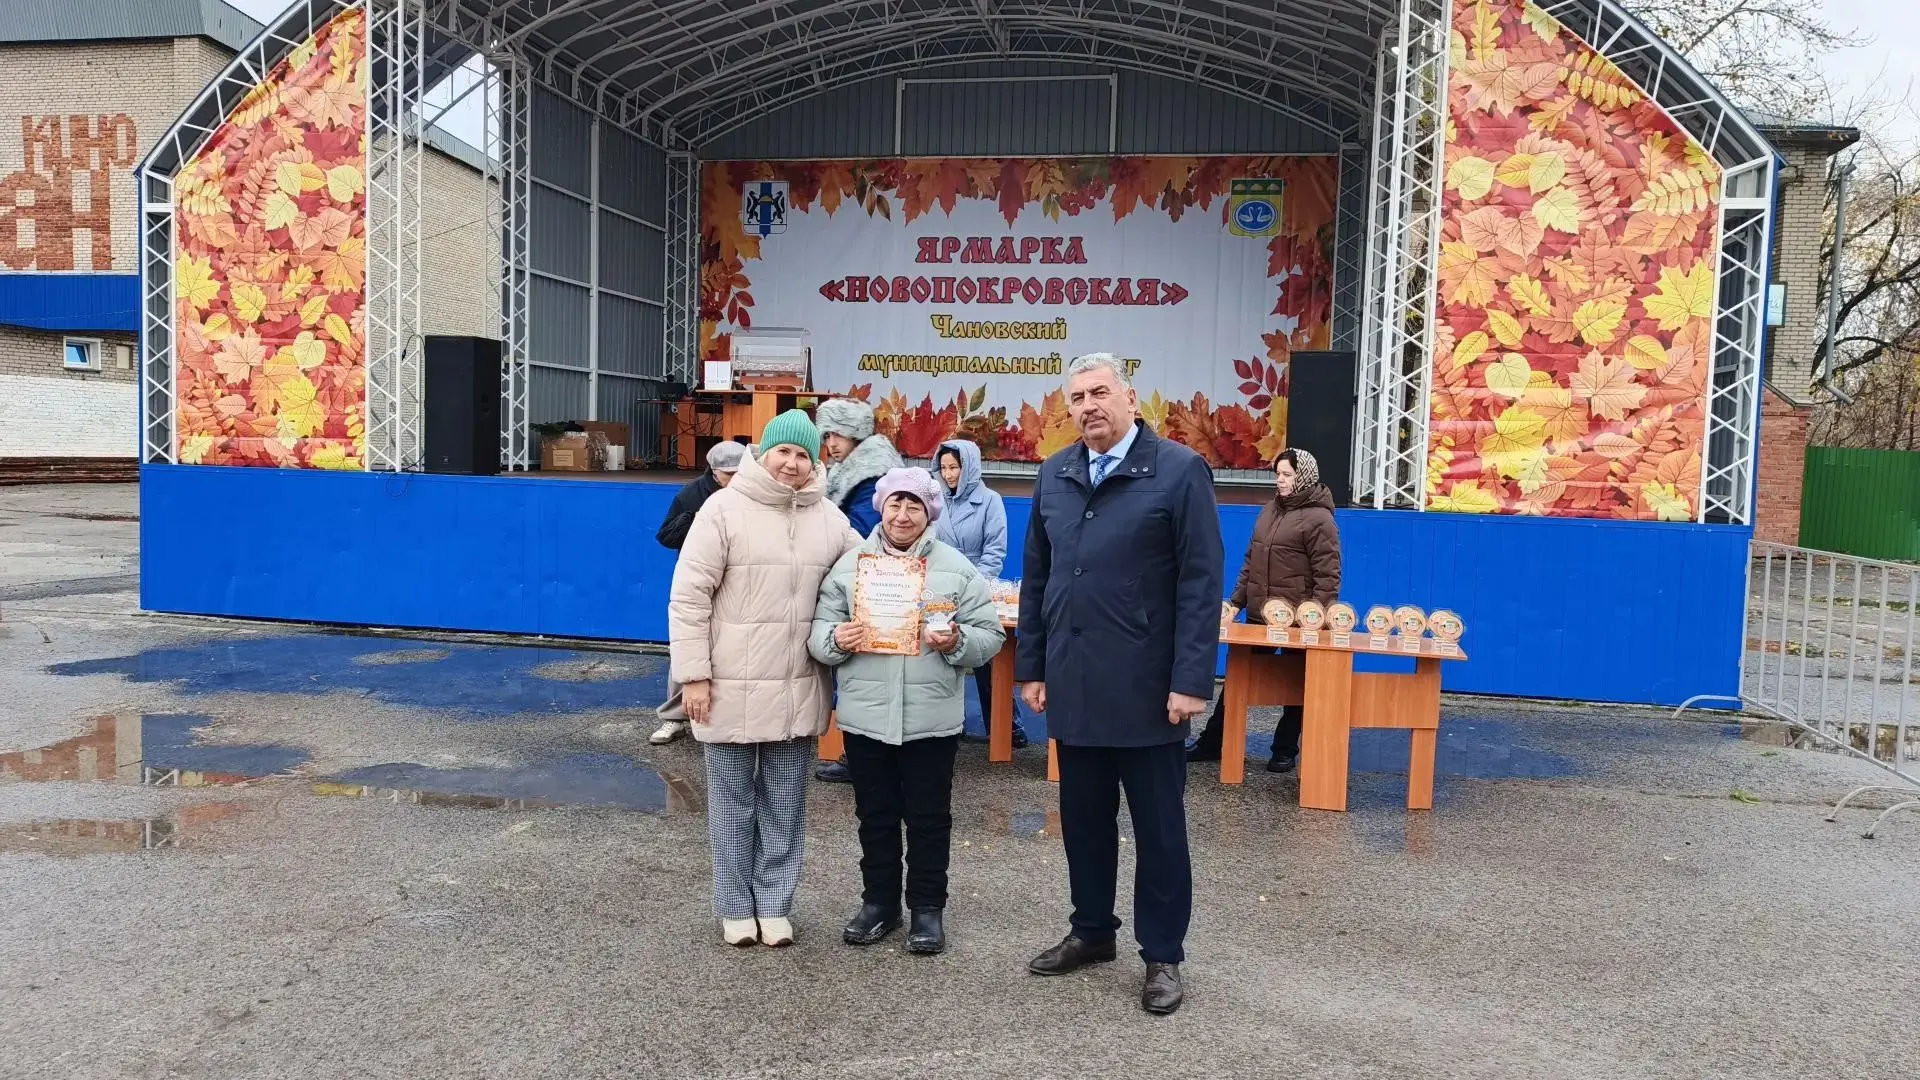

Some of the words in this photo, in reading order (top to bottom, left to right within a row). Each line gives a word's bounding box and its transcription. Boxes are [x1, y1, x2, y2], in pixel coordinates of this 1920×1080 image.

[915, 236, 1087, 264] ЯРМАРКА
[819, 275, 1189, 305] «НОВОПОКРОВСКАЯ»
[930, 314, 1067, 340] Чановский
[858, 352, 1061, 378] муниципальный
